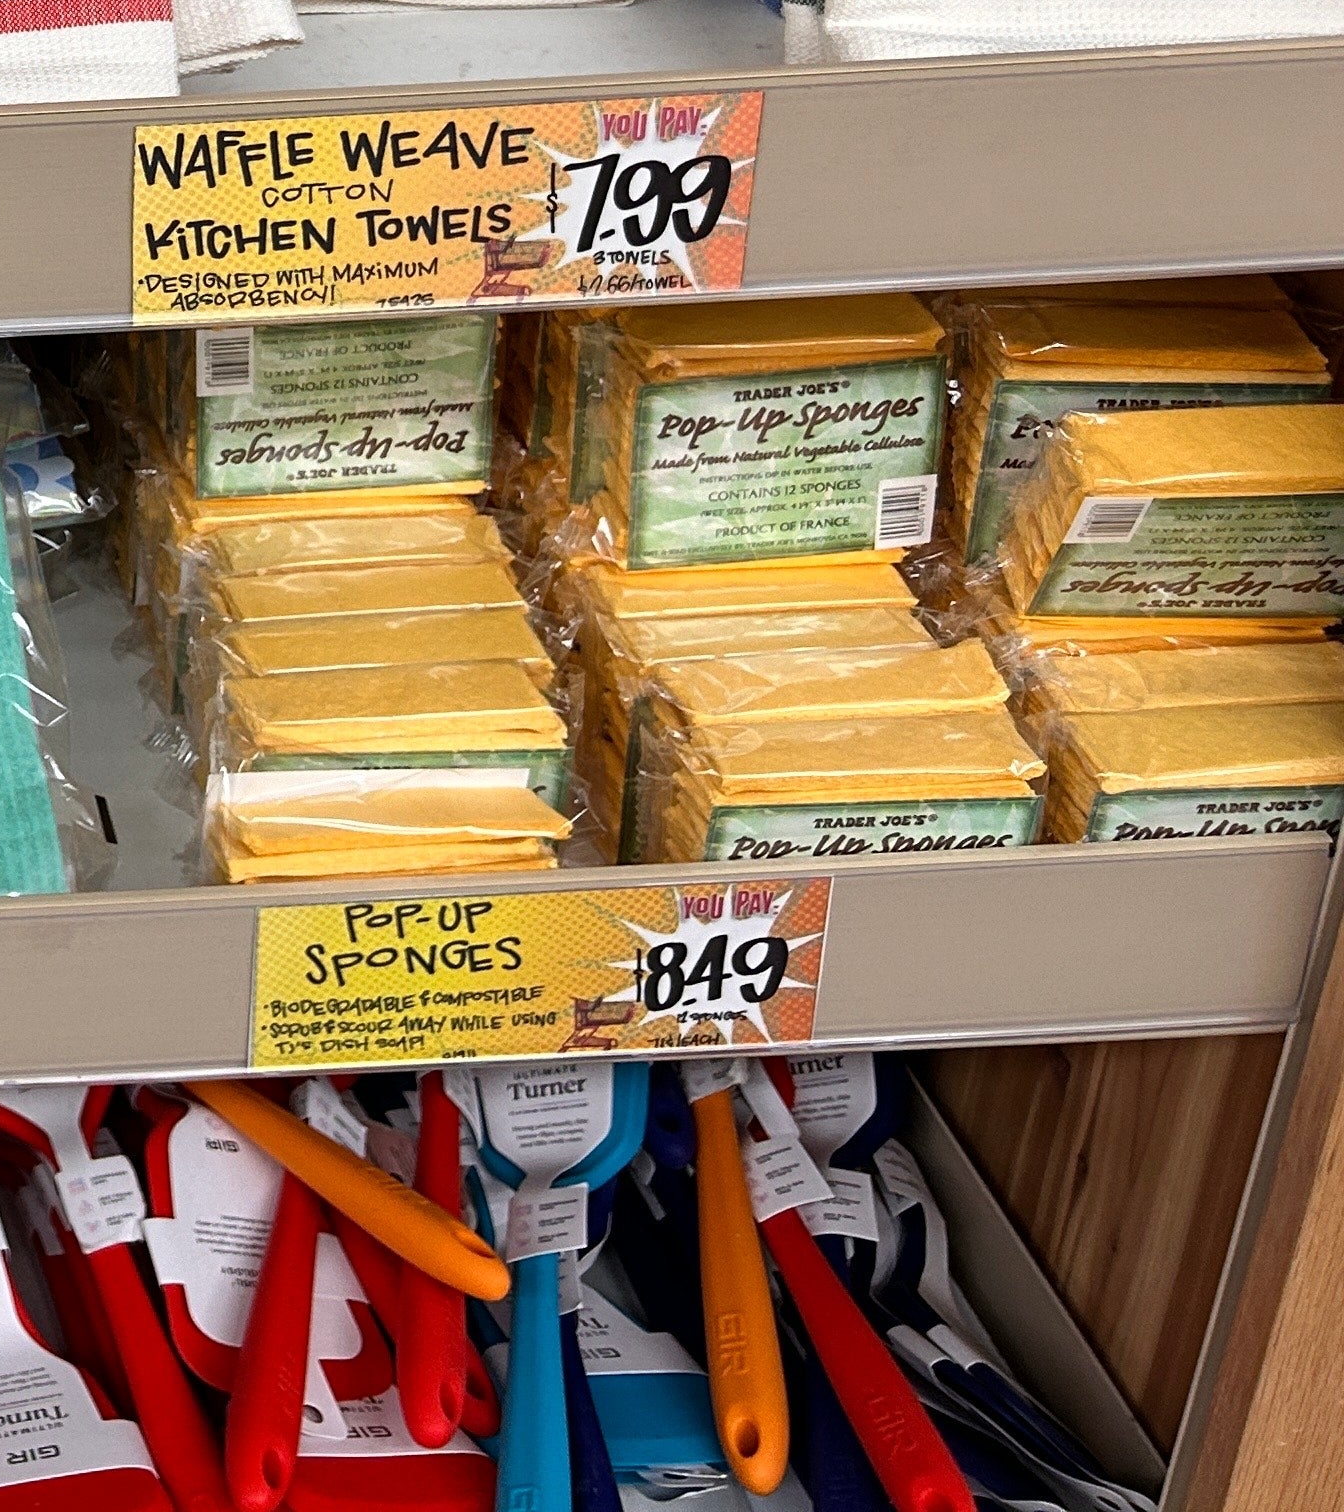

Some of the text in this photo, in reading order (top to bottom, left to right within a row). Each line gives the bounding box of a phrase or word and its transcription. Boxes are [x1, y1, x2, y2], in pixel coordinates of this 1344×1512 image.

[599, 110, 647, 142] YOU
[138, 120, 536, 188] WAFFLE WEAVE
[262, 179, 395, 207] COTTON
[545, 154, 732, 254] $7.99
[144, 204, 513, 261] KITCHEN TOWELS
[593, 248, 672, 266] 3 TOWELS
[146, 256, 438, 295] DESIGNED WITH MAXIMUM
[733, 388, 792, 402] TRADER
[656, 396, 924, 450] Pop-Up Sponges
[708, 478, 861, 502] CONTAINS 12 SPONGES
[715, 516, 850, 538] PRODUCT OF FRANCE
[343, 900, 493, 943] POP-UP
[683, 894, 724, 919] YOU
[304, 936, 523, 987] SPONGES
[633, 934, 789, 1012] $8.49
[398, 1017, 449, 1035] AWAY
[450, 1016, 505, 1031] WHILE
[512, 1012, 558, 1028] USING
[320, 1039, 369, 1052] DISH
